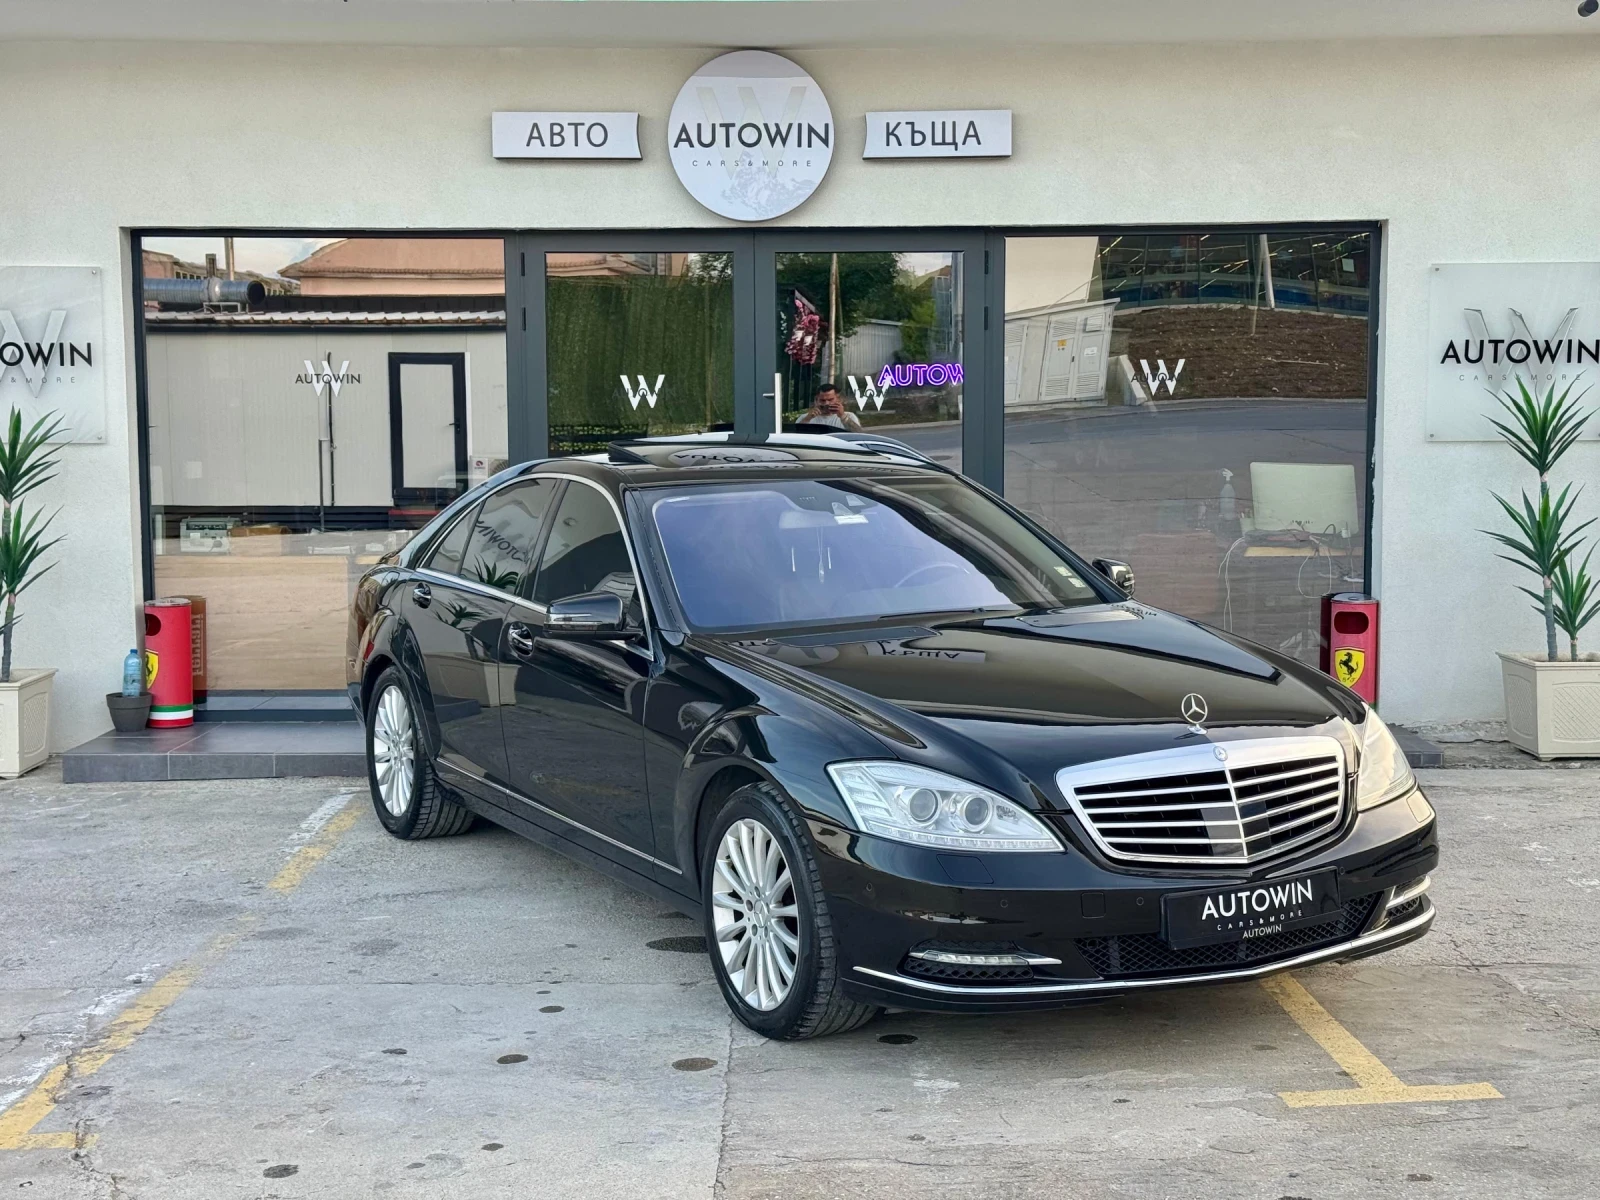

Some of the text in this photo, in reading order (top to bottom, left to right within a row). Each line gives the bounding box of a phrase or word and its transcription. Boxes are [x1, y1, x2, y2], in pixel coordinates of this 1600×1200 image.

[526, 122, 608, 148] АВТО
[673, 122, 830, 149] AUTOWIN
[885, 120, 982, 151] КЪЩА
[1440, 338, 1600, 364] AUTOWIN
[294, 373, 361, 384] AUTOWIN
[1201, 879, 1313, 920] AUTOWIN
[1242, 923, 1282, 939] AUTOWIN
